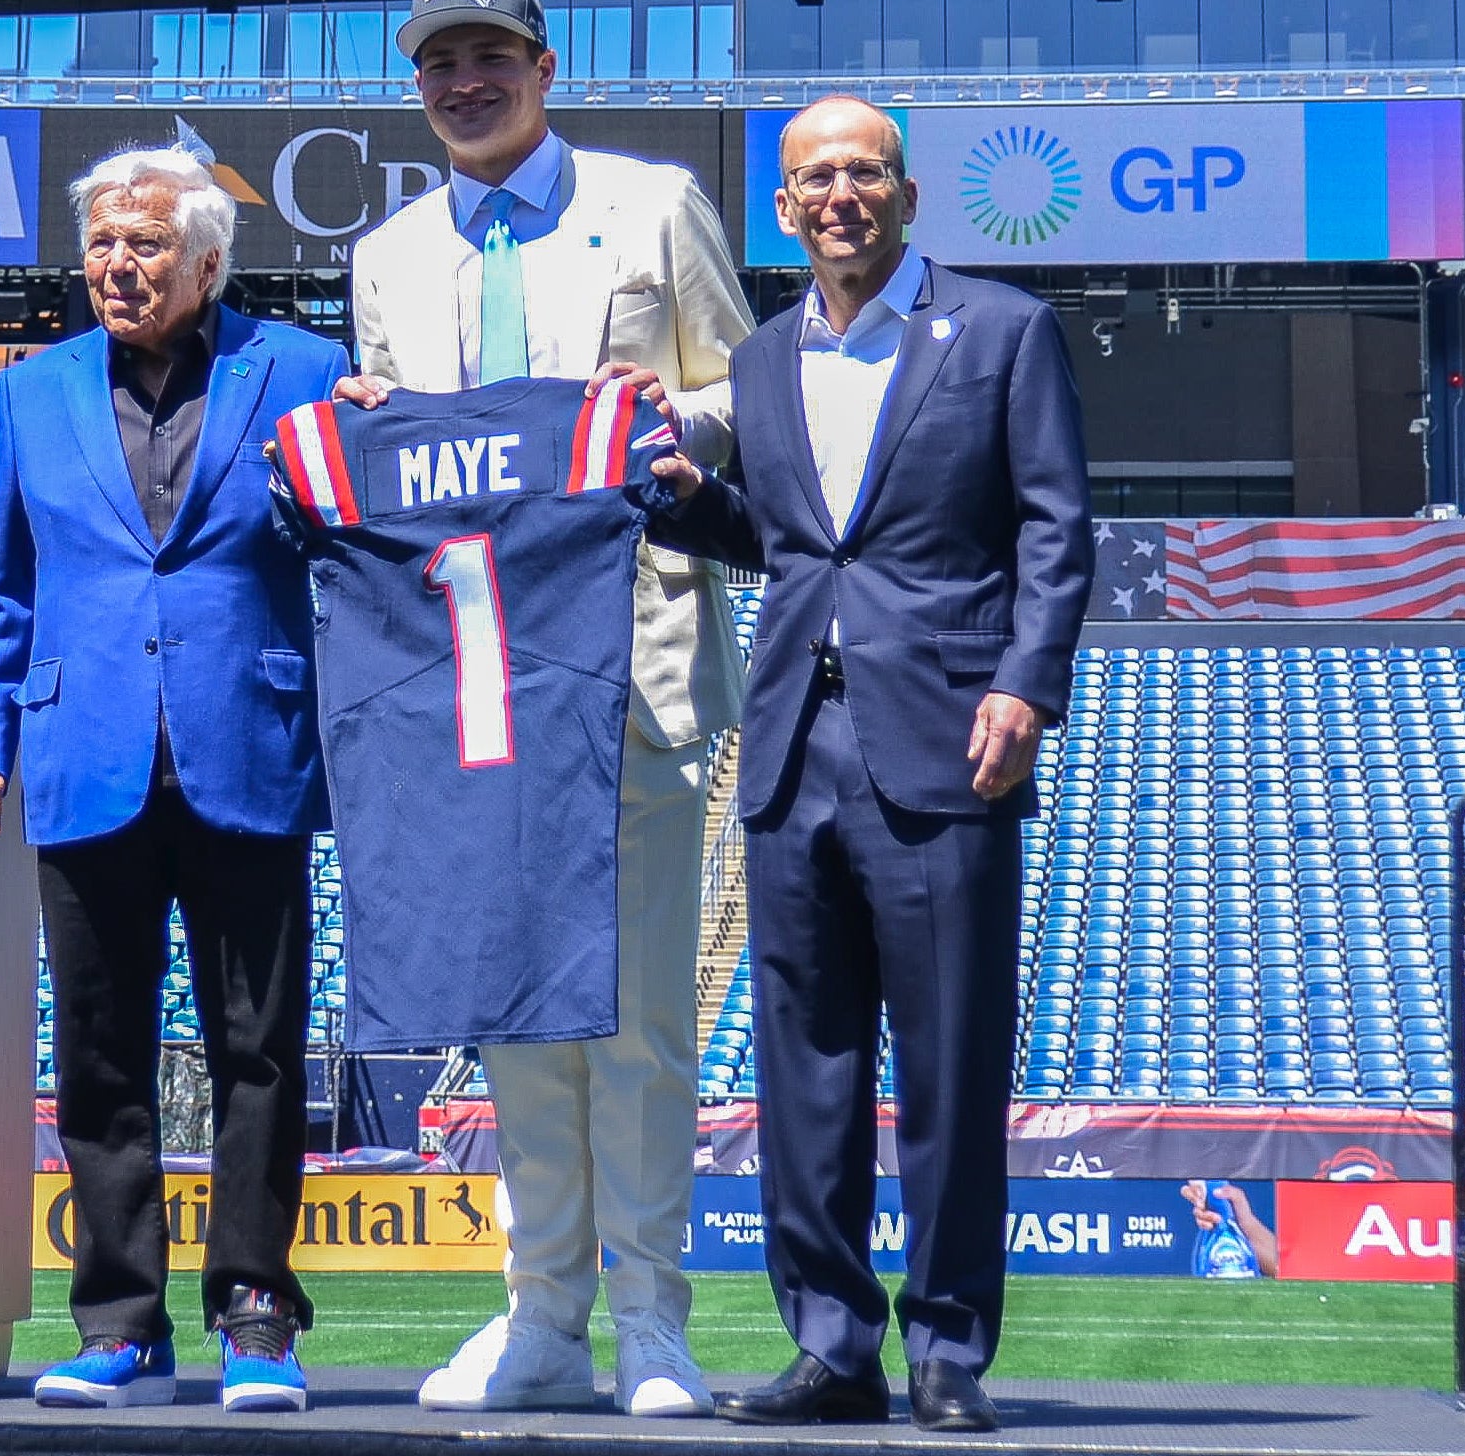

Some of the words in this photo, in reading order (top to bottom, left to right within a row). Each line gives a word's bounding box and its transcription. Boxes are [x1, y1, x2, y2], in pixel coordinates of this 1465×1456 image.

[397, 433, 521, 509] MAYE
[423, 532, 515, 769] 1
[1122, 1231, 1174, 1248] SPRAY
[1127, 1215, 1167, 1231] DISH
